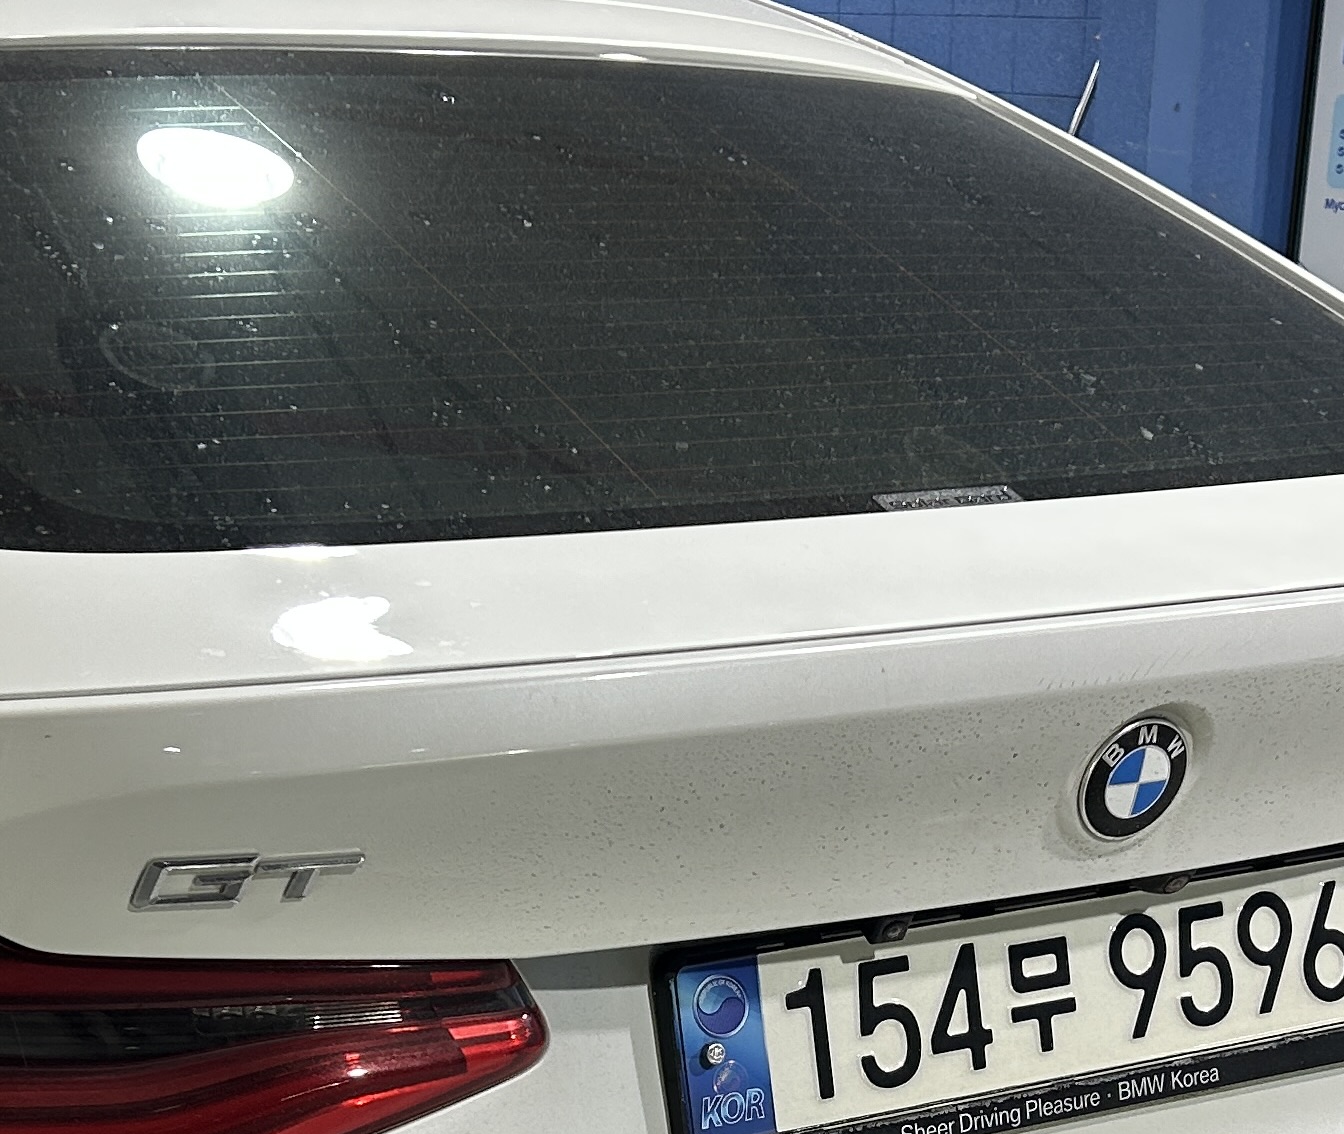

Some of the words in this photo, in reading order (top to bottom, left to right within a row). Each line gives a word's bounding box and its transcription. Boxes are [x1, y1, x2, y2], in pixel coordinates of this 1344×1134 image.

[1102, 725, 1185, 767] BMW
[128, 850, 365, 911] GT
[784, 935, 1077, 1100] 154무
[701, 1087, 765, 1130] KOR
[959, 1106, 1021, 1134] Driving
[1026, 1092, 1101, 1121] Pleasure
[1118, 1073, 1166, 1101] BMW
[1170, 1066, 1220, 1090] Korea
